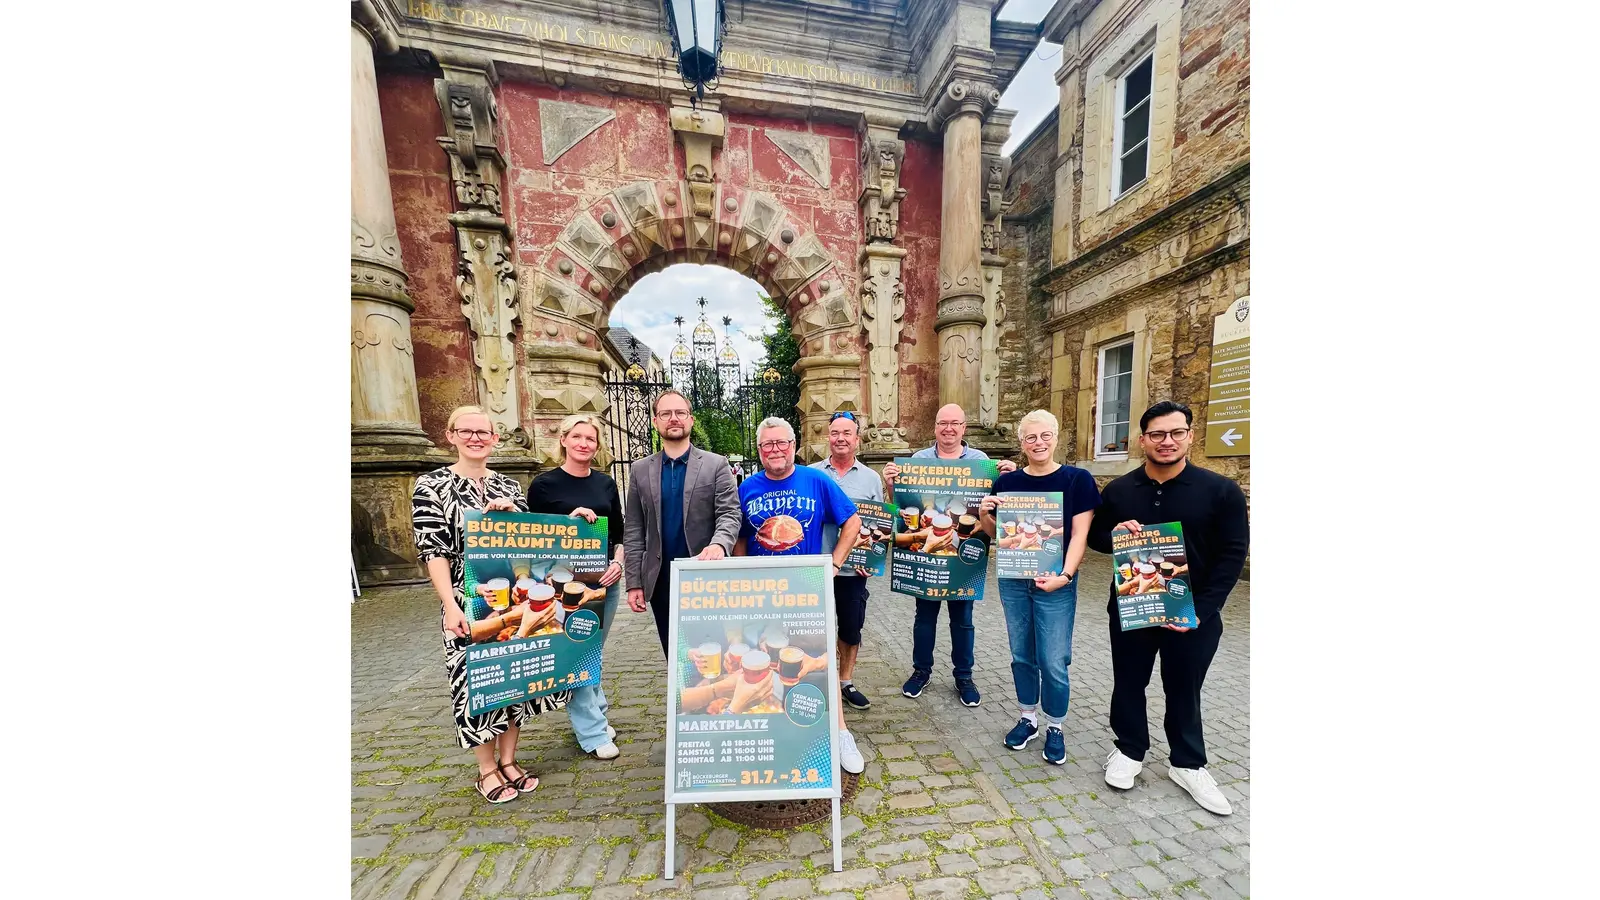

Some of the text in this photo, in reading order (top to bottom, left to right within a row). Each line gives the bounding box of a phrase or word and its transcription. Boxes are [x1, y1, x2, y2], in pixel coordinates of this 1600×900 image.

[896, 463, 971, 476] BÜCKEBURG
[894, 474, 992, 488] SCHÄUMT ÜBER
[762, 489, 797, 499] ORIGINAL
[1003, 495, 1045, 503] ÜCKEBURG
[746, 496, 816, 516] Bayern
[856, 503, 882, 511] KEBURG
[467, 518, 578, 537] BÜCKEBURG
[467, 534, 601, 550] SCHÄUMT ÜBER
[1151, 536, 1179, 544] ÜBER
[893, 552, 947, 565] MARKTPLATZ
[680, 577, 789, 594] BÜCKEBURG
[926, 588, 949, 597] 31.7.
[680, 591, 819, 609] SCHÄUMT ÜBER
[469, 639, 551, 660] MARKTPLATZ
[470, 664, 501, 676] FREITAG
[541, 653, 555, 661] UHR
[470, 671, 505, 682] SAMSTAG
[471, 677, 505, 690] SONNTAG
[523, 670, 540, 678] 11:00
[527, 677, 557, 695] 31.7.
[567, 670, 592, 684] 2.8.
[485, 690, 524, 704] STADTMARKETING
[792, 693, 823, 705] VERKAUFS-
[793, 698, 817, 709] OFFENER
[791, 702, 817, 714] SONNTAG
[804, 712, 816, 720] UHR
[678, 719, 769, 731] MARKTPLATZ
[678, 756, 714, 764] SONNTAG
[740, 770, 778, 785] 31.7.
[791, 768, 824, 783] 2.8.
